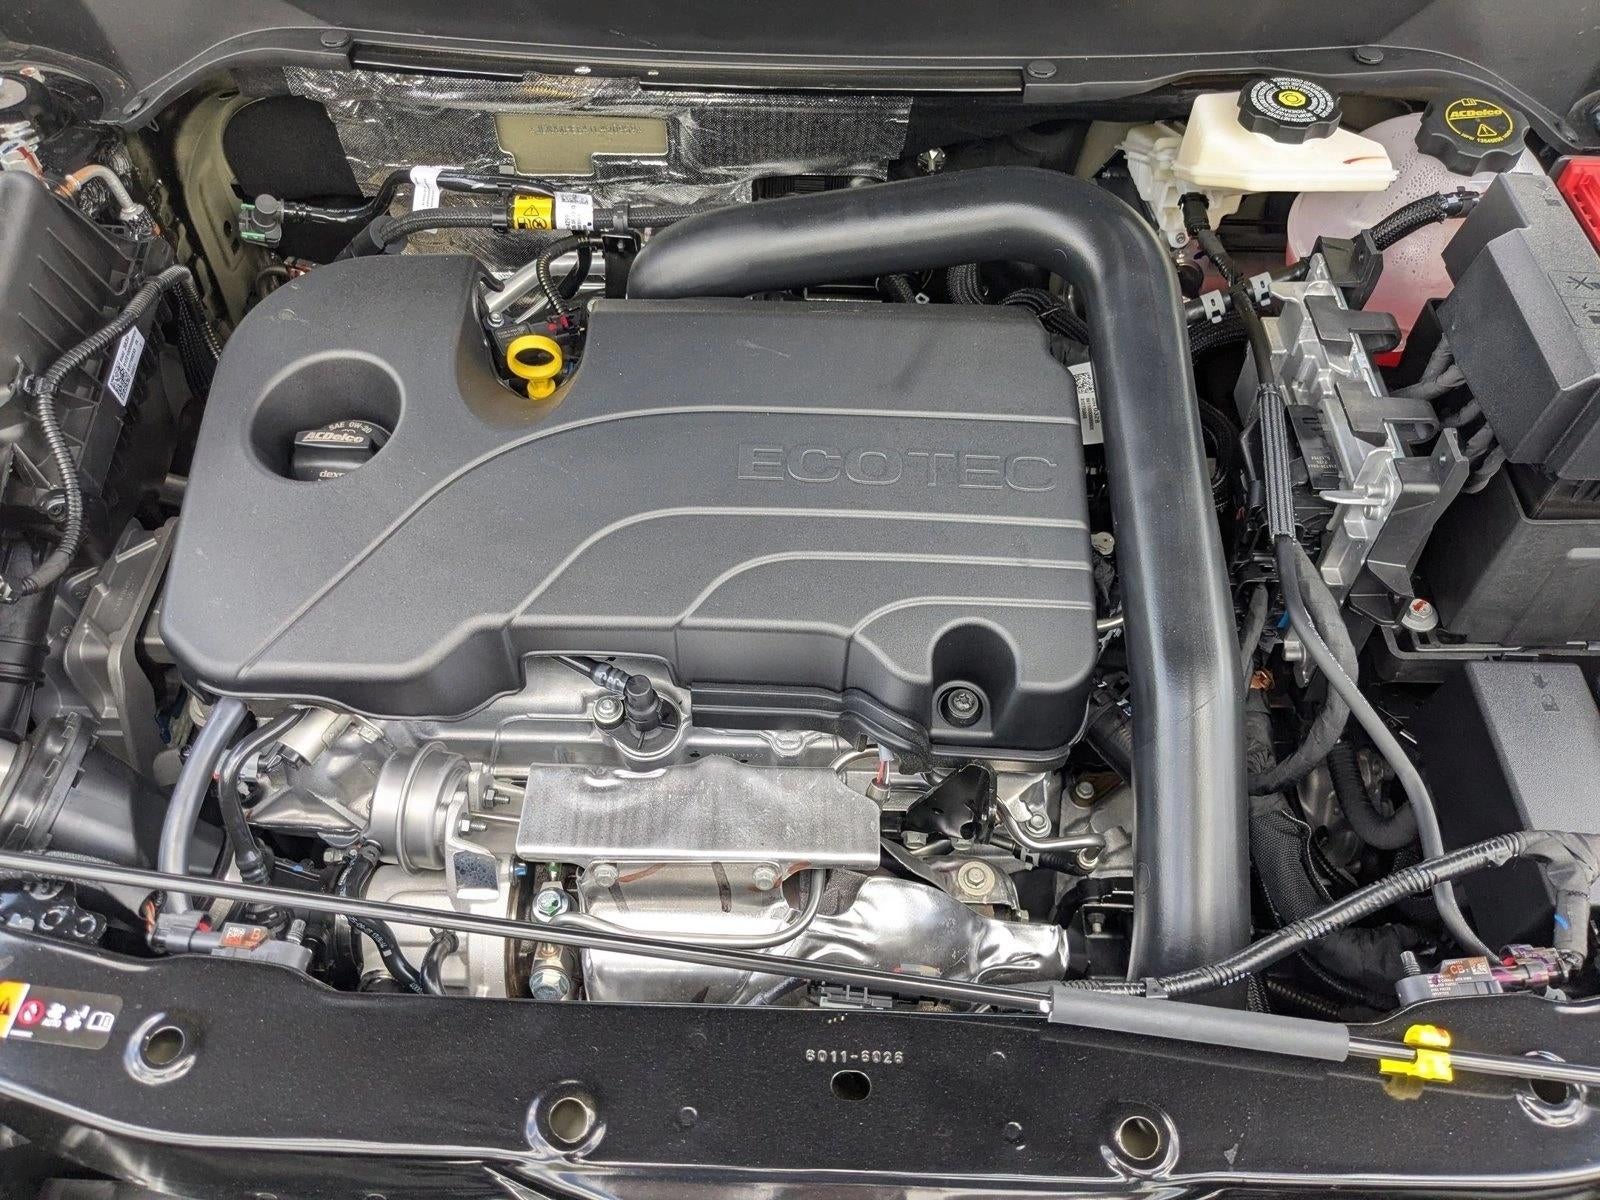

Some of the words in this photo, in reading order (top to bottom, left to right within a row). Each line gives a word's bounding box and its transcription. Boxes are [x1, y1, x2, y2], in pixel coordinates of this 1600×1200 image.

[1450, 109, 1502, 119] ACDelco
[328, 421, 345, 431] SAE
[348, 421, 373, 434] 0W-20
[302, 431, 364, 443] ACDelco
[737, 443, 1058, 491] ECOTEC
